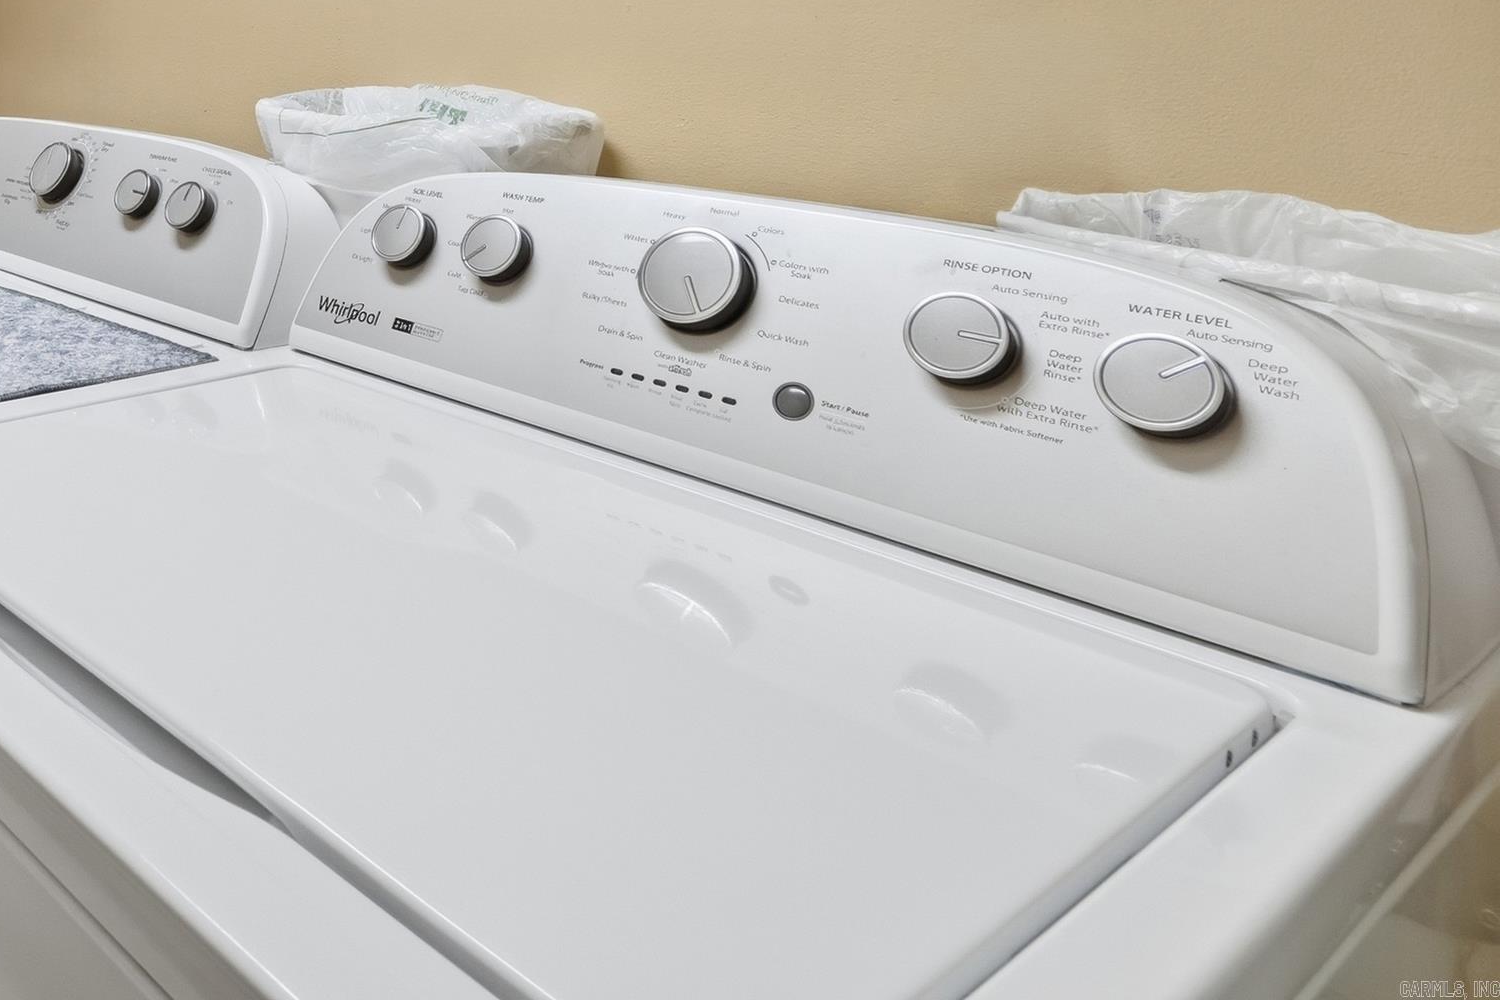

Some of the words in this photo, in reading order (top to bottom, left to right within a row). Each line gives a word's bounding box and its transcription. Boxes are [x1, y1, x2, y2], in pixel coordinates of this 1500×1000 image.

[710, 206, 740, 218] Normal
[757, 225, 785, 236] Colors
[778, 259, 807, 272] Colors
[942, 258, 978, 275] RINSE
[981, 263, 1033, 281] OPTION
[790, 270, 812, 281] Soak
[778, 295, 820, 310] Delicates
[991, 283, 1020, 297] Auto
[1022, 288, 1069, 305] Sensing
[317, 295, 382, 327] Whirlpool
[1040, 310, 1070, 325] Auto
[1072, 315, 1101, 329] with
[1127, 303, 1183, 322] WATER
[1185, 312, 1234, 330] LEVEL
[597, 324, 618, 336] Drain
[626, 331, 644, 343] Spin
[1038, 319, 1068, 334] Extra
[757, 329, 783, 343] Quick
[784, 335, 810, 348] Wash
[1186, 328, 1218, 343] Auto
[1220, 333, 1275, 353] Sensing
[653, 350, 677, 362] Clean
[677, 355, 708, 369] Washer
[718, 352, 741, 366] Rinse
[743, 360, 750, 369] &
[751, 361, 772, 374] Spin
[1049, 349, 1083, 364] Deep
[1046, 359, 1083, 375] Water
[1247, 357, 1289, 376] Deep
[1253, 371, 1299, 388] Water
[1259, 383, 1301, 400] Wash
[820, 400, 841, 411] Start
[846, 406, 870, 418] Pause
[996, 402, 1024, 418] with
[1025, 410, 1056, 425] Extra
[1014, 395, 1048, 413] Deep
[1052, 404, 1088, 421] Water
[980, 418, 999, 430] with
[999, 423, 1025, 436] Fabric
[1026, 429, 1065, 446] Softener
